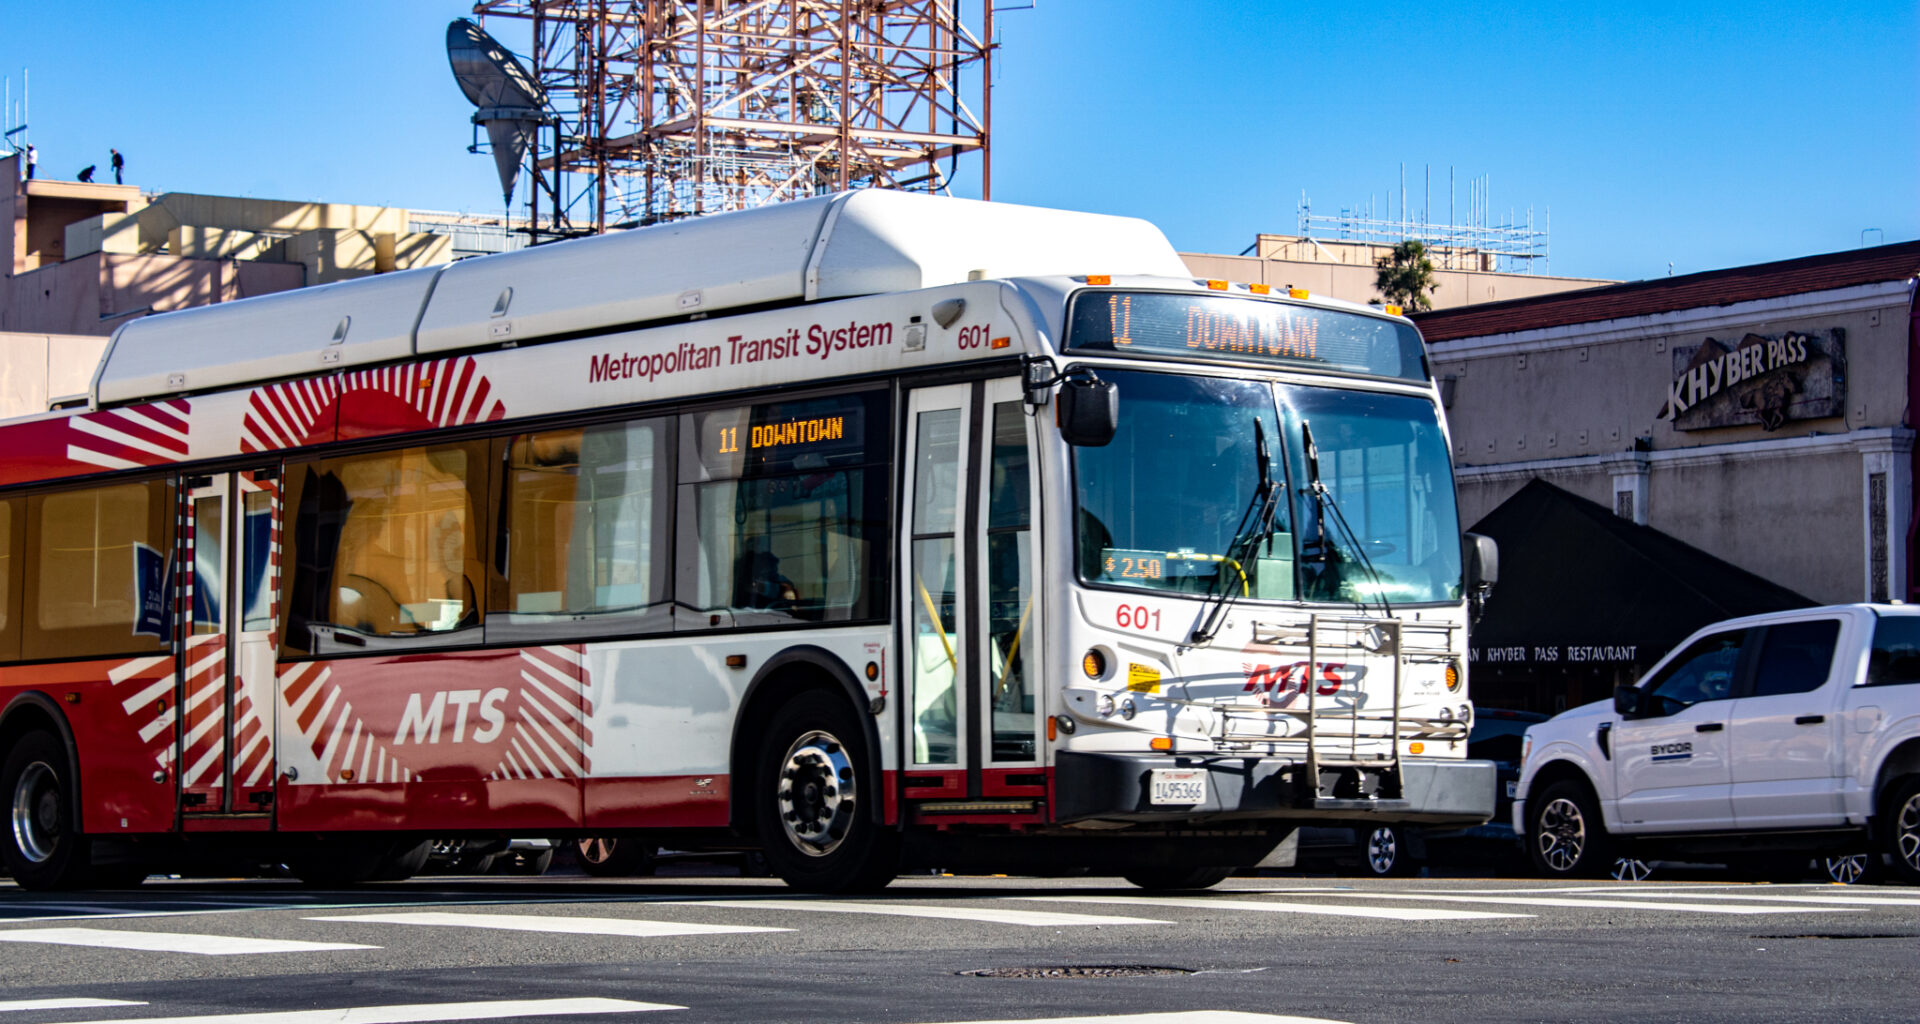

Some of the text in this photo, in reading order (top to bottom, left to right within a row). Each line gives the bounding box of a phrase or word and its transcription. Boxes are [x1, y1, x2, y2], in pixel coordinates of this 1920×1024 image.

[1109, 295, 1132, 344] 11
[589, 321, 893, 383] Metropolitan Transit System
[957, 323, 991, 350] 601
[1667, 335, 1807, 422] KHYBER PASS
[719, 416, 843, 453] 11 DOWNTOWN
[1105, 557, 1161, 579] $ 2.50
[1116, 603, 1161, 632] 601
[1487, 647, 1526, 661] KHYBER
[1534, 646, 1559, 661] PASS
[1567, 646, 1637, 661] RESTAURANT
[1242, 661, 1346, 696] MTS
[392, 687, 510, 745] MTS
[1650, 742, 1692, 755] BYCOR
[1155, 782, 1203, 799] 1495366
